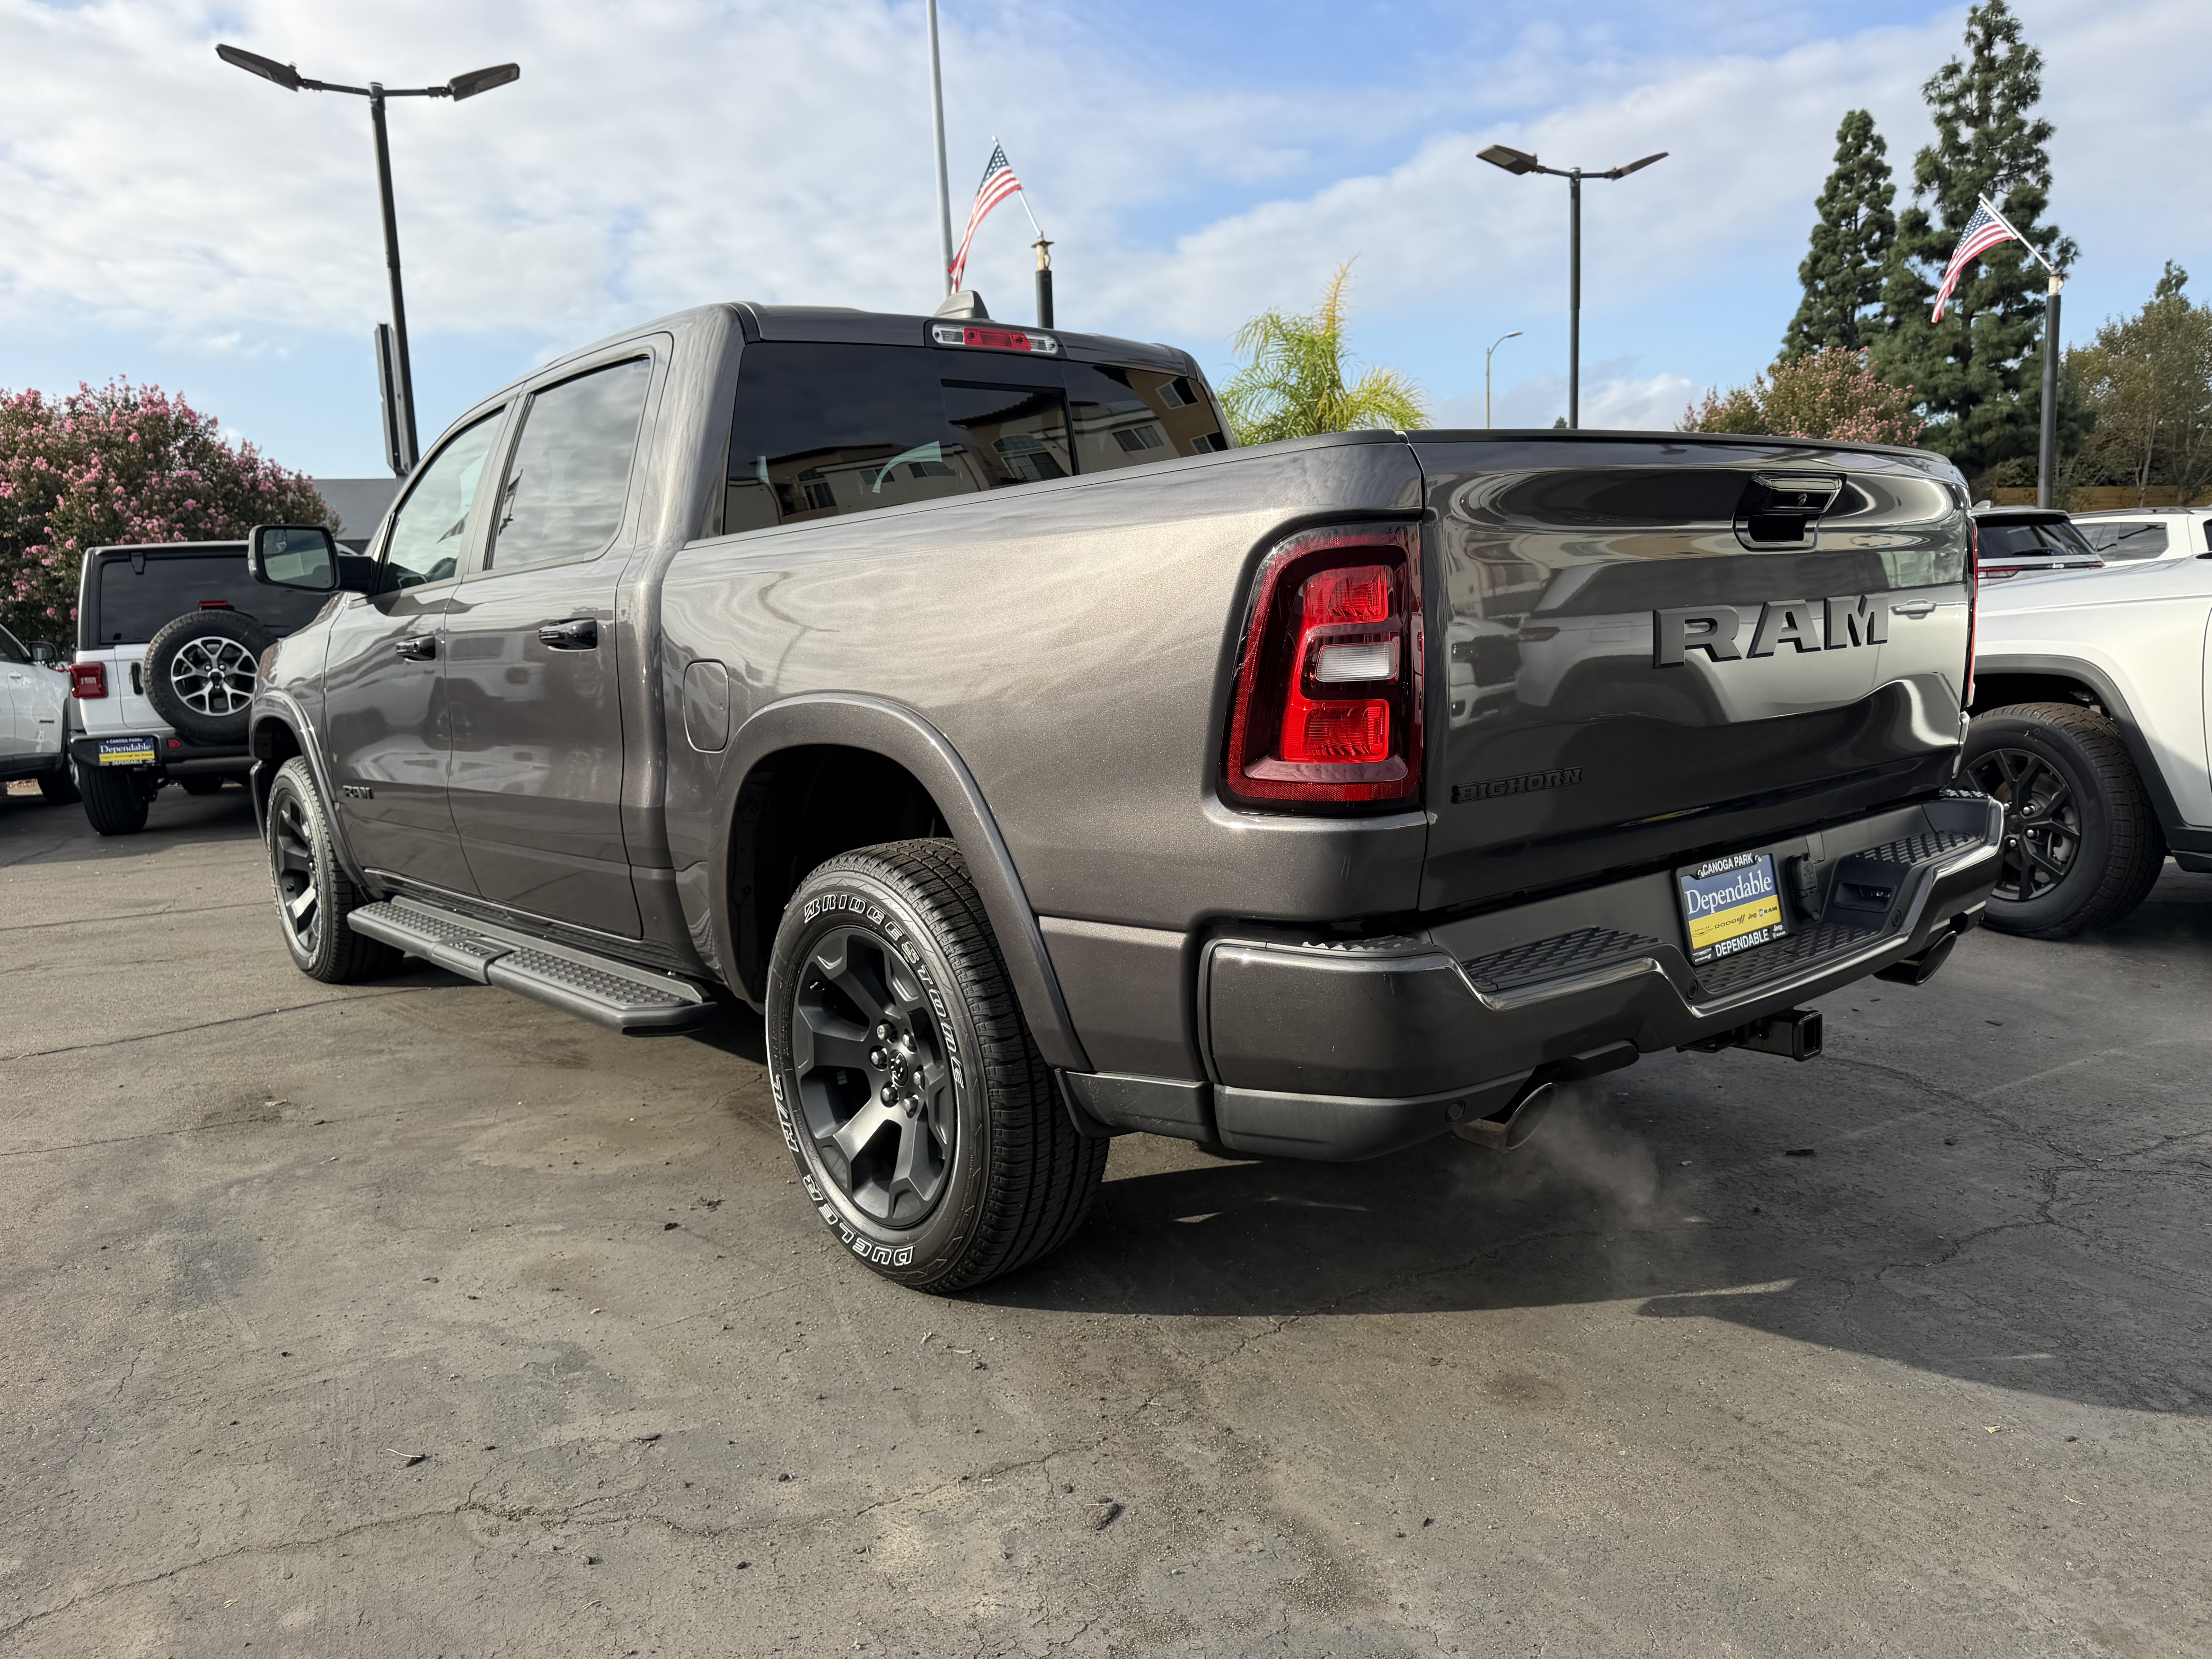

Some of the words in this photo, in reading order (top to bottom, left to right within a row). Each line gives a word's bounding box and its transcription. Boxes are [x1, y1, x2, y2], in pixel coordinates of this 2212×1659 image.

[1653, 594, 1889, 669] RAM
[100, 742, 151, 754] Dependable
[343, 785, 374, 800] RAM
[1451, 766, 1583, 804] BIGHORN
[1702, 857, 1734, 875] CANOGA
[1733, 852, 1753, 867] PARK
[1685, 869, 1772, 914] Dependable
[1764, 906, 1778, 914] RAM
[1715, 928, 1770, 957] DEPENDABLE
[804, 893, 965, 1089] BRIDGESTONE
[803, 1173, 915, 1266] DUELER
